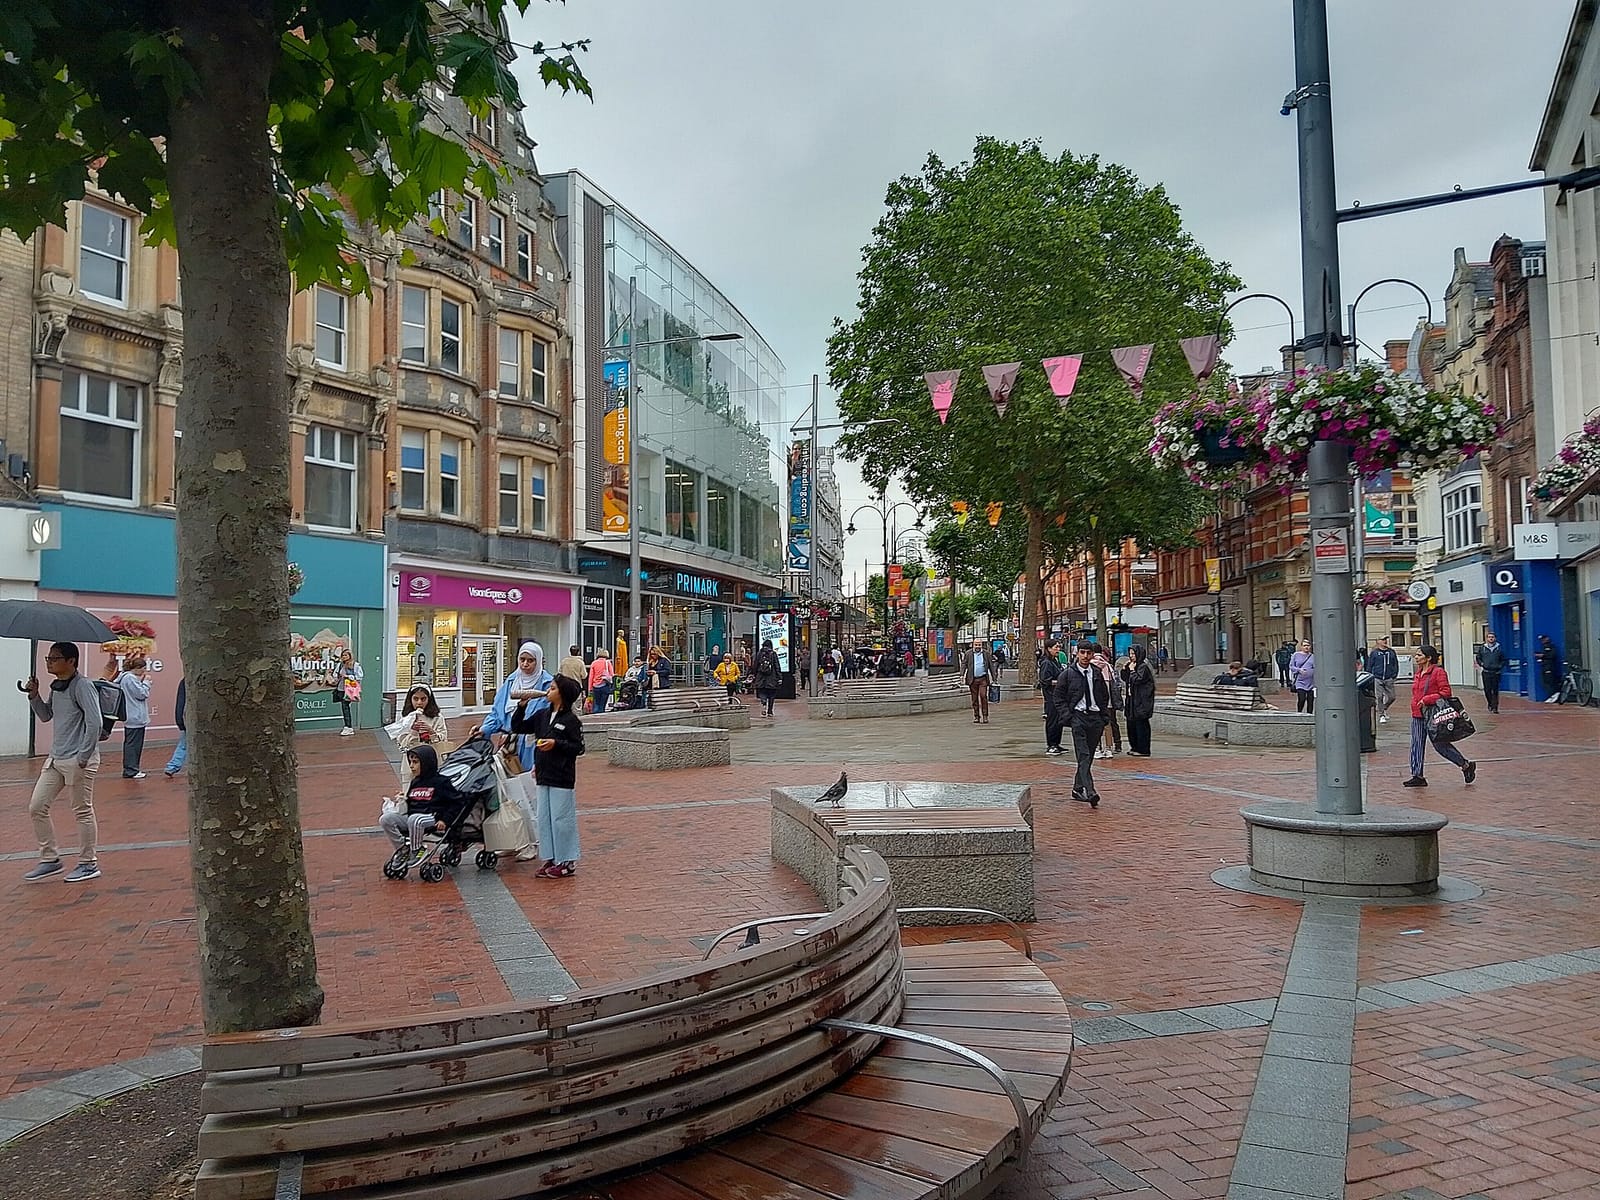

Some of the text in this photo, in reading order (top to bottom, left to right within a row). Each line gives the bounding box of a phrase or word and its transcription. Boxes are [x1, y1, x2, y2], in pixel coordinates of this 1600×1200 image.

[616, 367, 627, 464] visit-reading.com
[800, 442, 809, 517] visit-reading.com
[1523, 534, 1548, 544] M&S
[677, 573, 718, 597] PRIMARK
[116, 656, 163, 671] Tte
[291, 656, 335, 670] Munch
[296, 700, 327, 709] ORACLE
